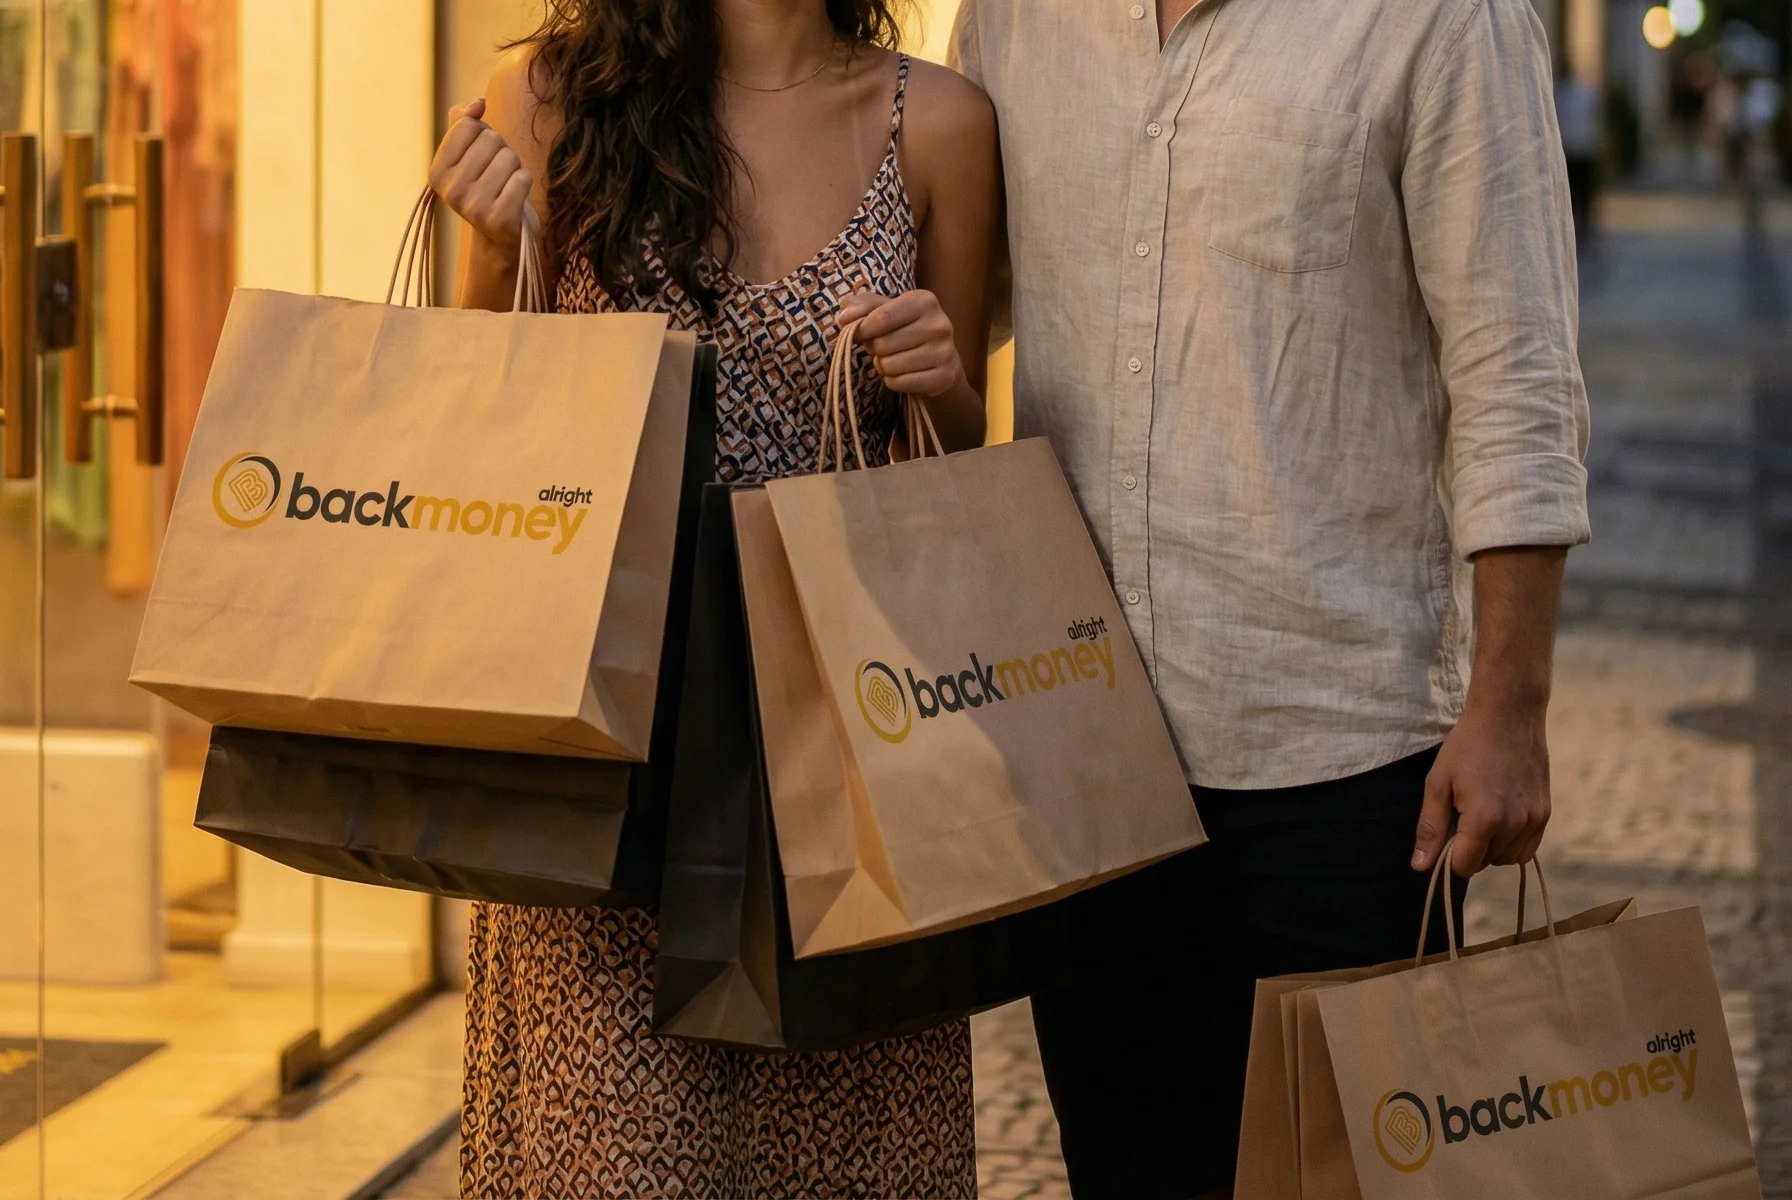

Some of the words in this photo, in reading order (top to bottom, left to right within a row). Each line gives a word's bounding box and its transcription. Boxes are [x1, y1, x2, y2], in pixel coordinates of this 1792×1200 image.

[285, 472, 589, 555] backmoney
[538, 485, 593, 508] alright
[1067, 616, 1108, 641] alright
[904, 636, 1116, 718] backmoney
[1647, 1029, 1697, 1054] alright
[1436, 1049, 1699, 1145] backmoney
